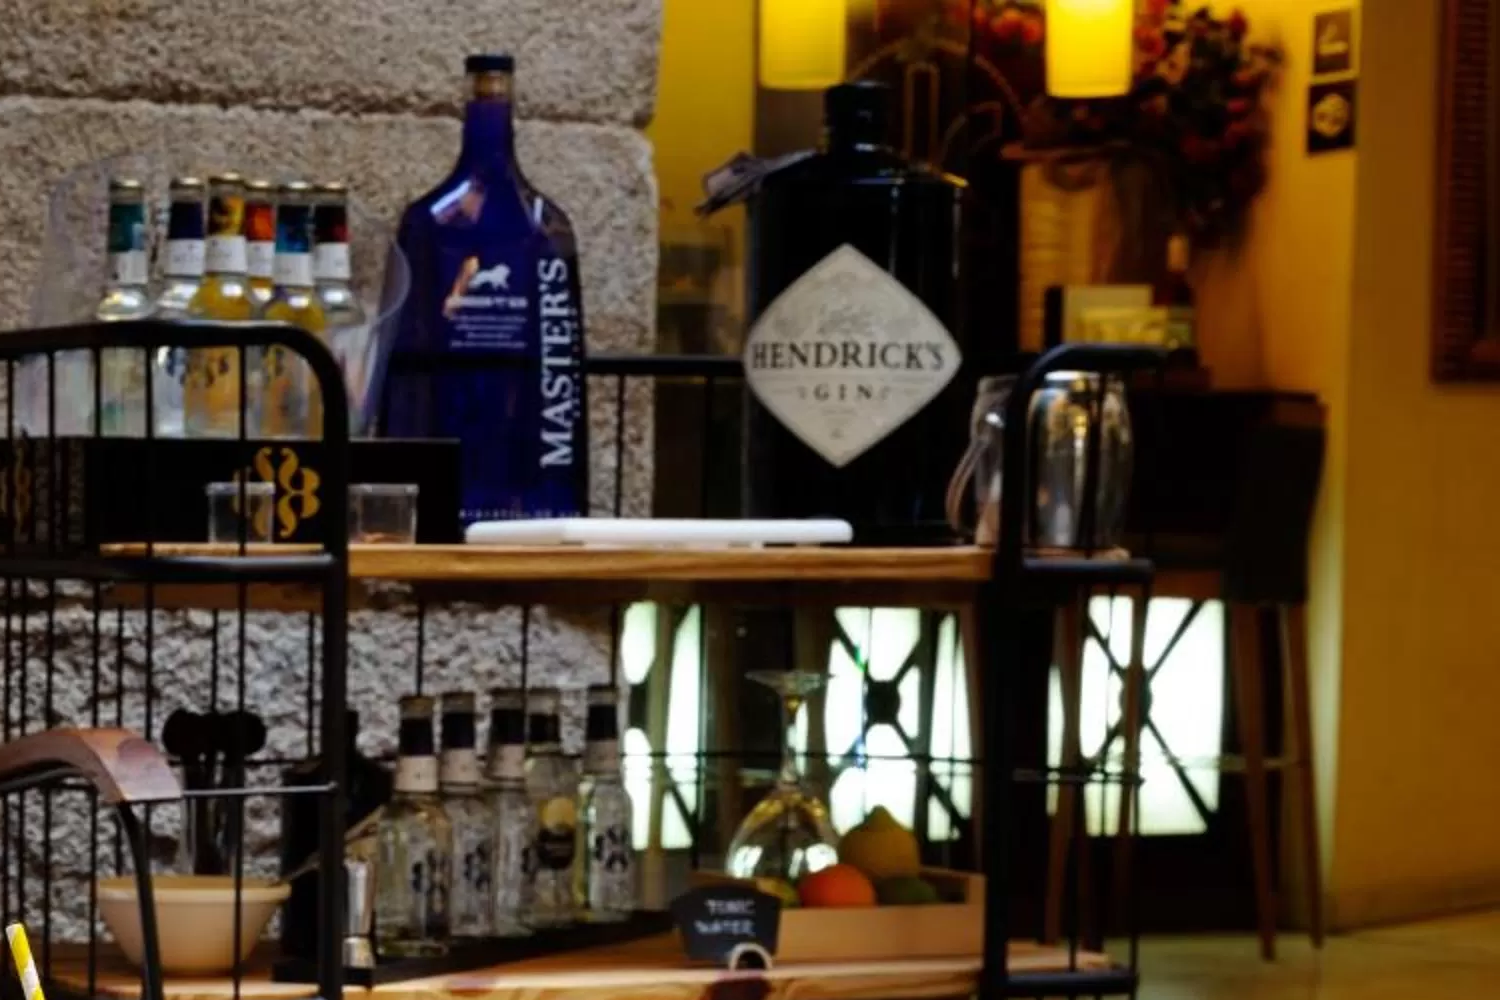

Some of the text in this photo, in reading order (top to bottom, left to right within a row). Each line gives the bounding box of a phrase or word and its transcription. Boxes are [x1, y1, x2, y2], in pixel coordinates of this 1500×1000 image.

[538, 257, 574, 468] MASTER'S
[752, 340, 945, 372] HENDRICK'S
[812, 383, 873, 402] GIN
